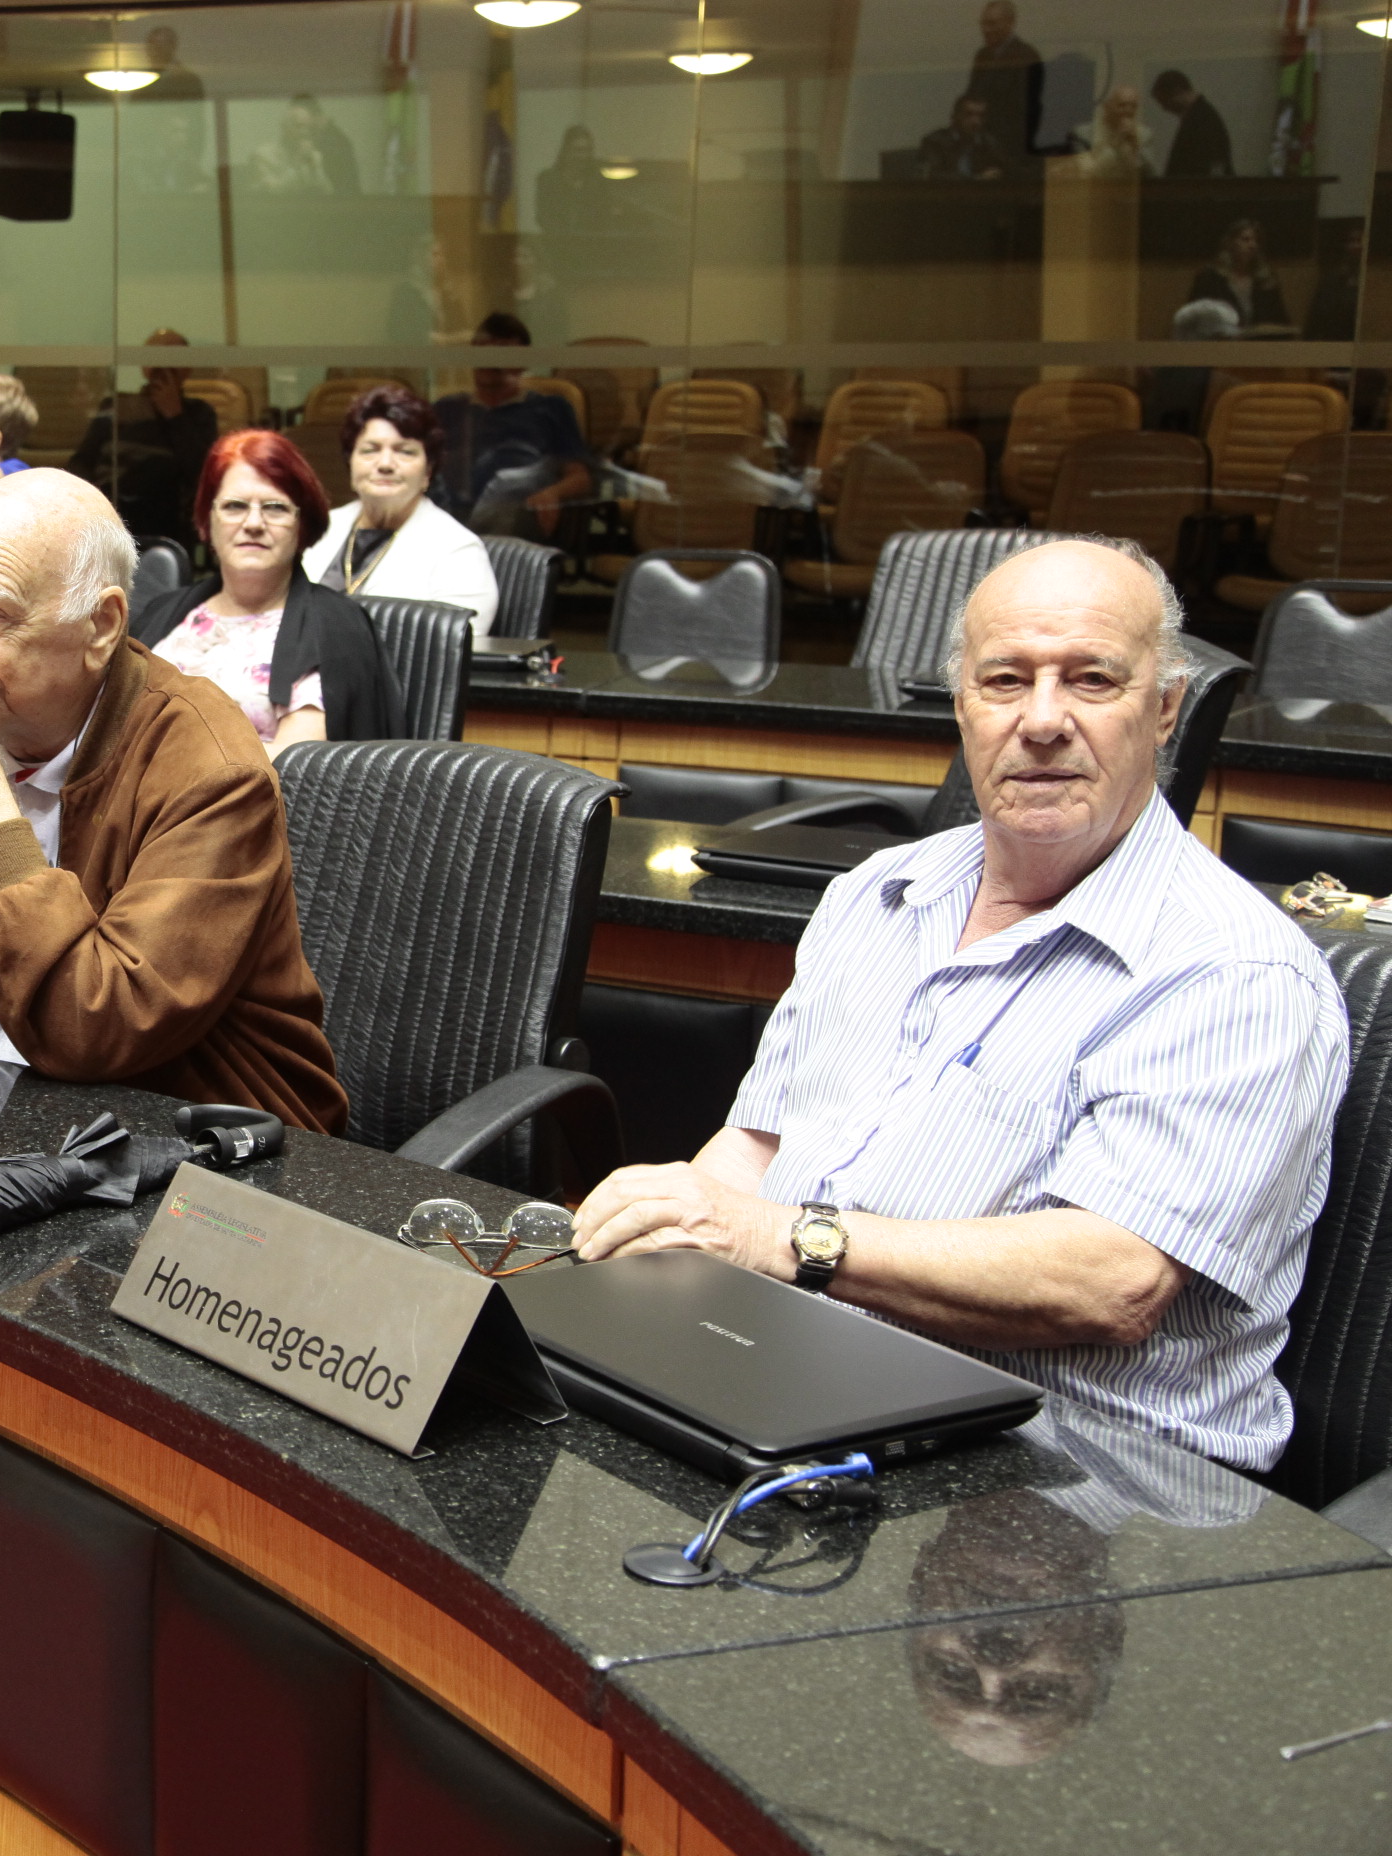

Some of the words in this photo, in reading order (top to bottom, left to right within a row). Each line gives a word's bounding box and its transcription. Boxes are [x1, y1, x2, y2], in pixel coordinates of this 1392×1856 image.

[228, 1217, 267, 1239] LEGISLATIVA
[144, 1256, 412, 1410] Homenageados
[699, 1321, 756, 1346] POSITIVO
